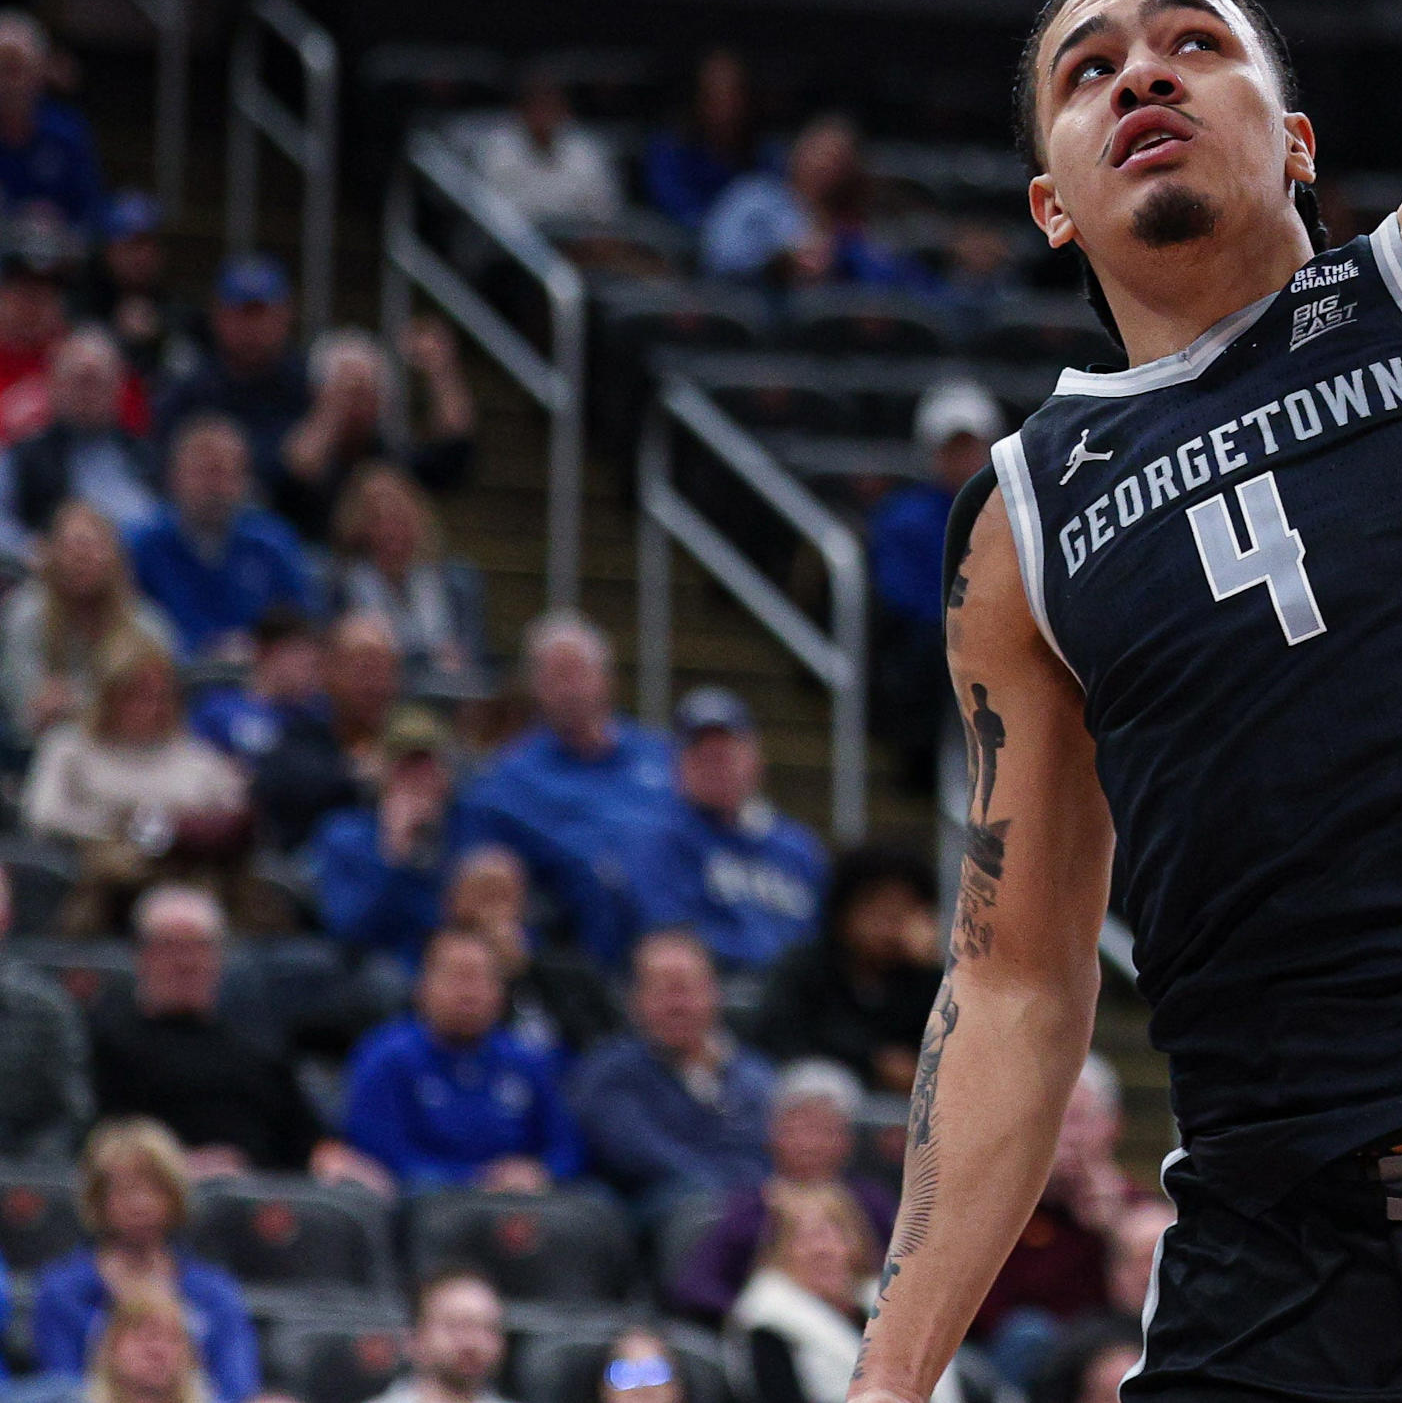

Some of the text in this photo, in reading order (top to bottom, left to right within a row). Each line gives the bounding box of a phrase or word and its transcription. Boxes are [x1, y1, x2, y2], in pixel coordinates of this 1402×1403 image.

[1290, 266, 1360, 294] CHANGE
[1294, 259, 1354, 282] BE THE
[1291, 301, 1358, 343] EAST
[1293, 293, 1340, 327] BIG
[1185, 471, 1327, 646] 4
